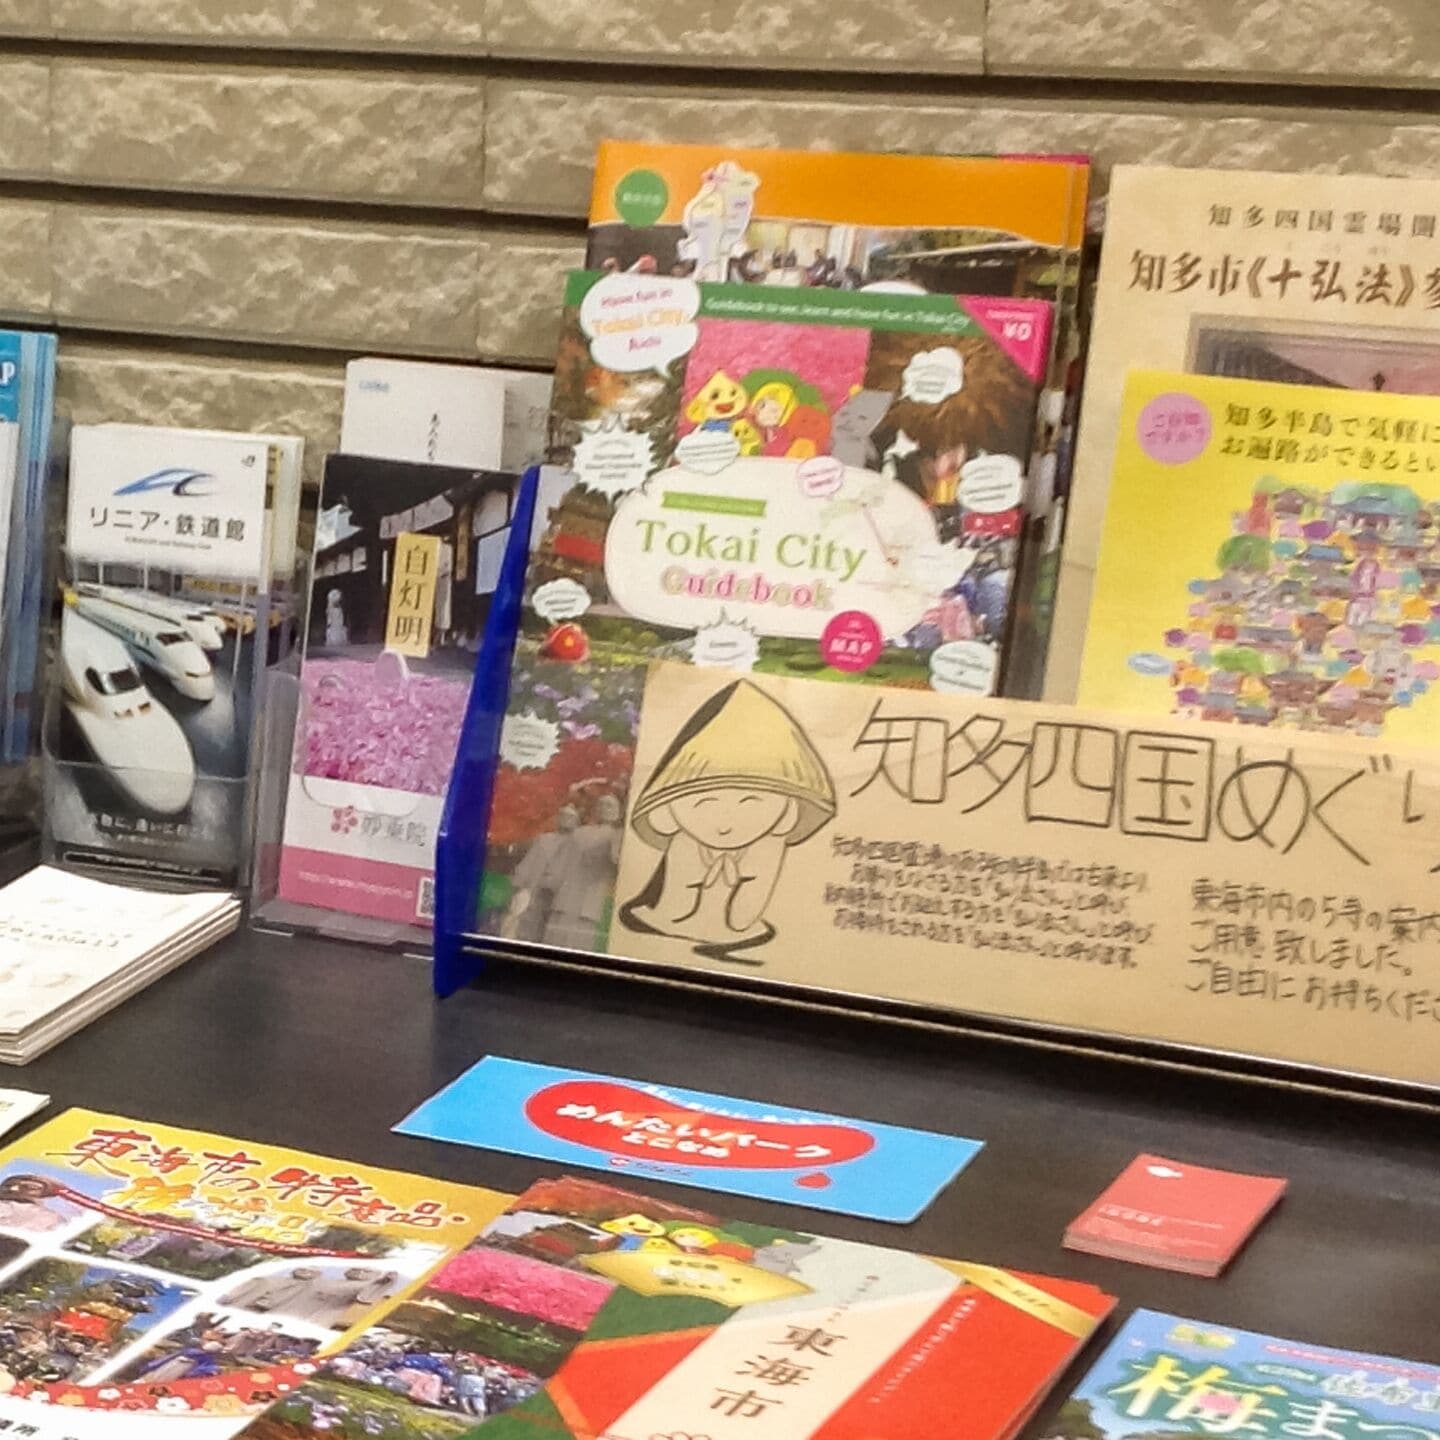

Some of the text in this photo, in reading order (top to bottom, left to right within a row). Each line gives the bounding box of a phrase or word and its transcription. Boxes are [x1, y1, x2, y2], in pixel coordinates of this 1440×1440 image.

[88, 507, 247, 542] リニア・鉄道館
[636, 518, 867, 581] Tokai City
[660, 566, 836, 612] Guidebook
[555, 1101, 835, 1160] めんたいパーク
[620, 1130, 731, 1160] とこなめ
[709, 1323, 848, 1420] 東海市
